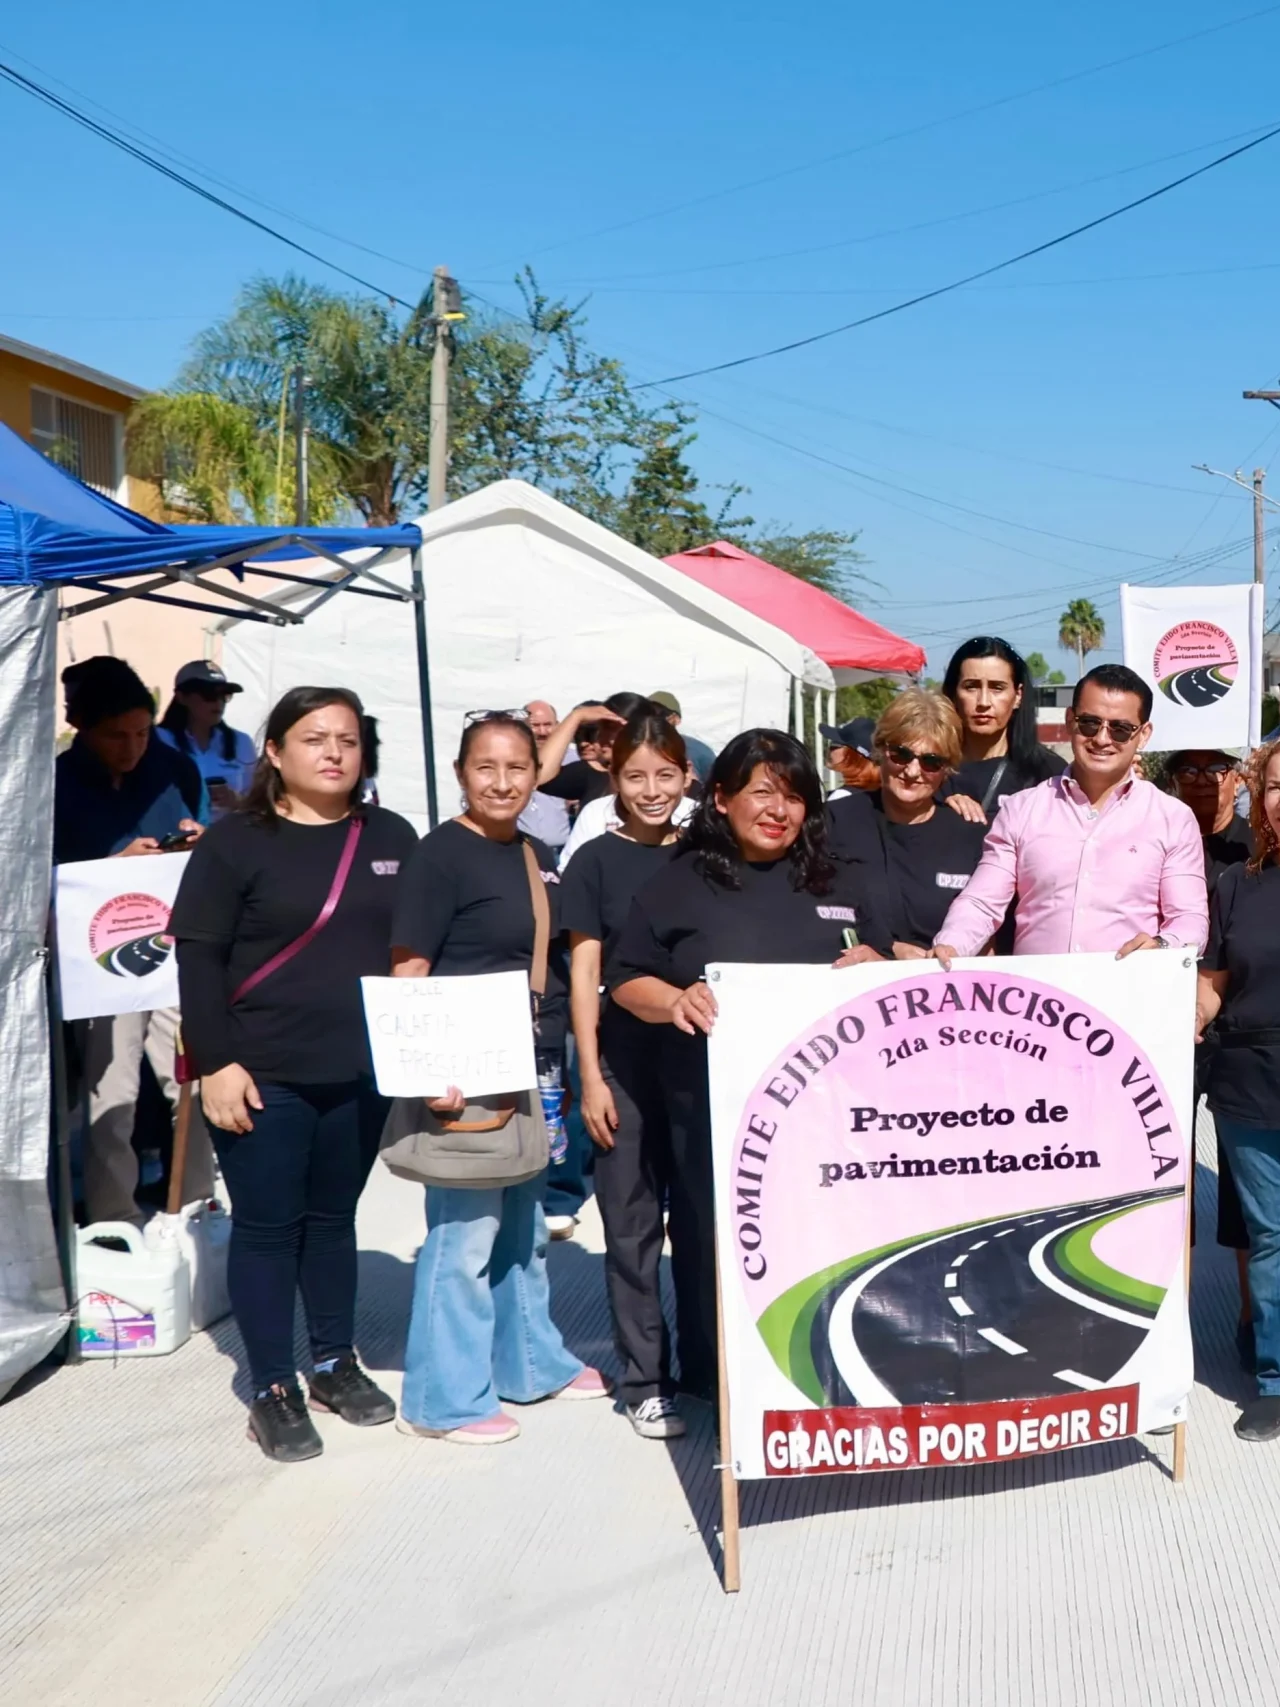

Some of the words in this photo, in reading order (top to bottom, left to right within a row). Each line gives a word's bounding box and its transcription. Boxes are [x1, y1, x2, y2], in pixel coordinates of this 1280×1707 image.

[1153, 648, 1163, 678] COMITE
[1180, 622, 1225, 638] FRANCISCO
[1223, 637, 1237, 661] VILLA
[399, 981, 443, 997] CALLE
[398, 1048, 513, 1079] PRESENTE
[878, 1037, 929, 1068] 2da
[938, 1026, 1048, 1062] Sección
[736, 1113, 778, 1281] COMITE
[763, 1015, 865, 1110] EJIDO
[875, 982, 1115, 1057] FRANCISCO
[1121, 1056, 1179, 1181] VILLA
[850, 1102, 1015, 1137] Proyecto
[1025, 1099, 1069, 1124] de
[819, 1143, 1101, 1188] pavimentación
[766, 1426, 908, 1470] GRACIAS
[919, 1422, 987, 1463] POR
[997, 1409, 1092, 1457] DECIR
[1099, 1402, 1129, 1438] SI
